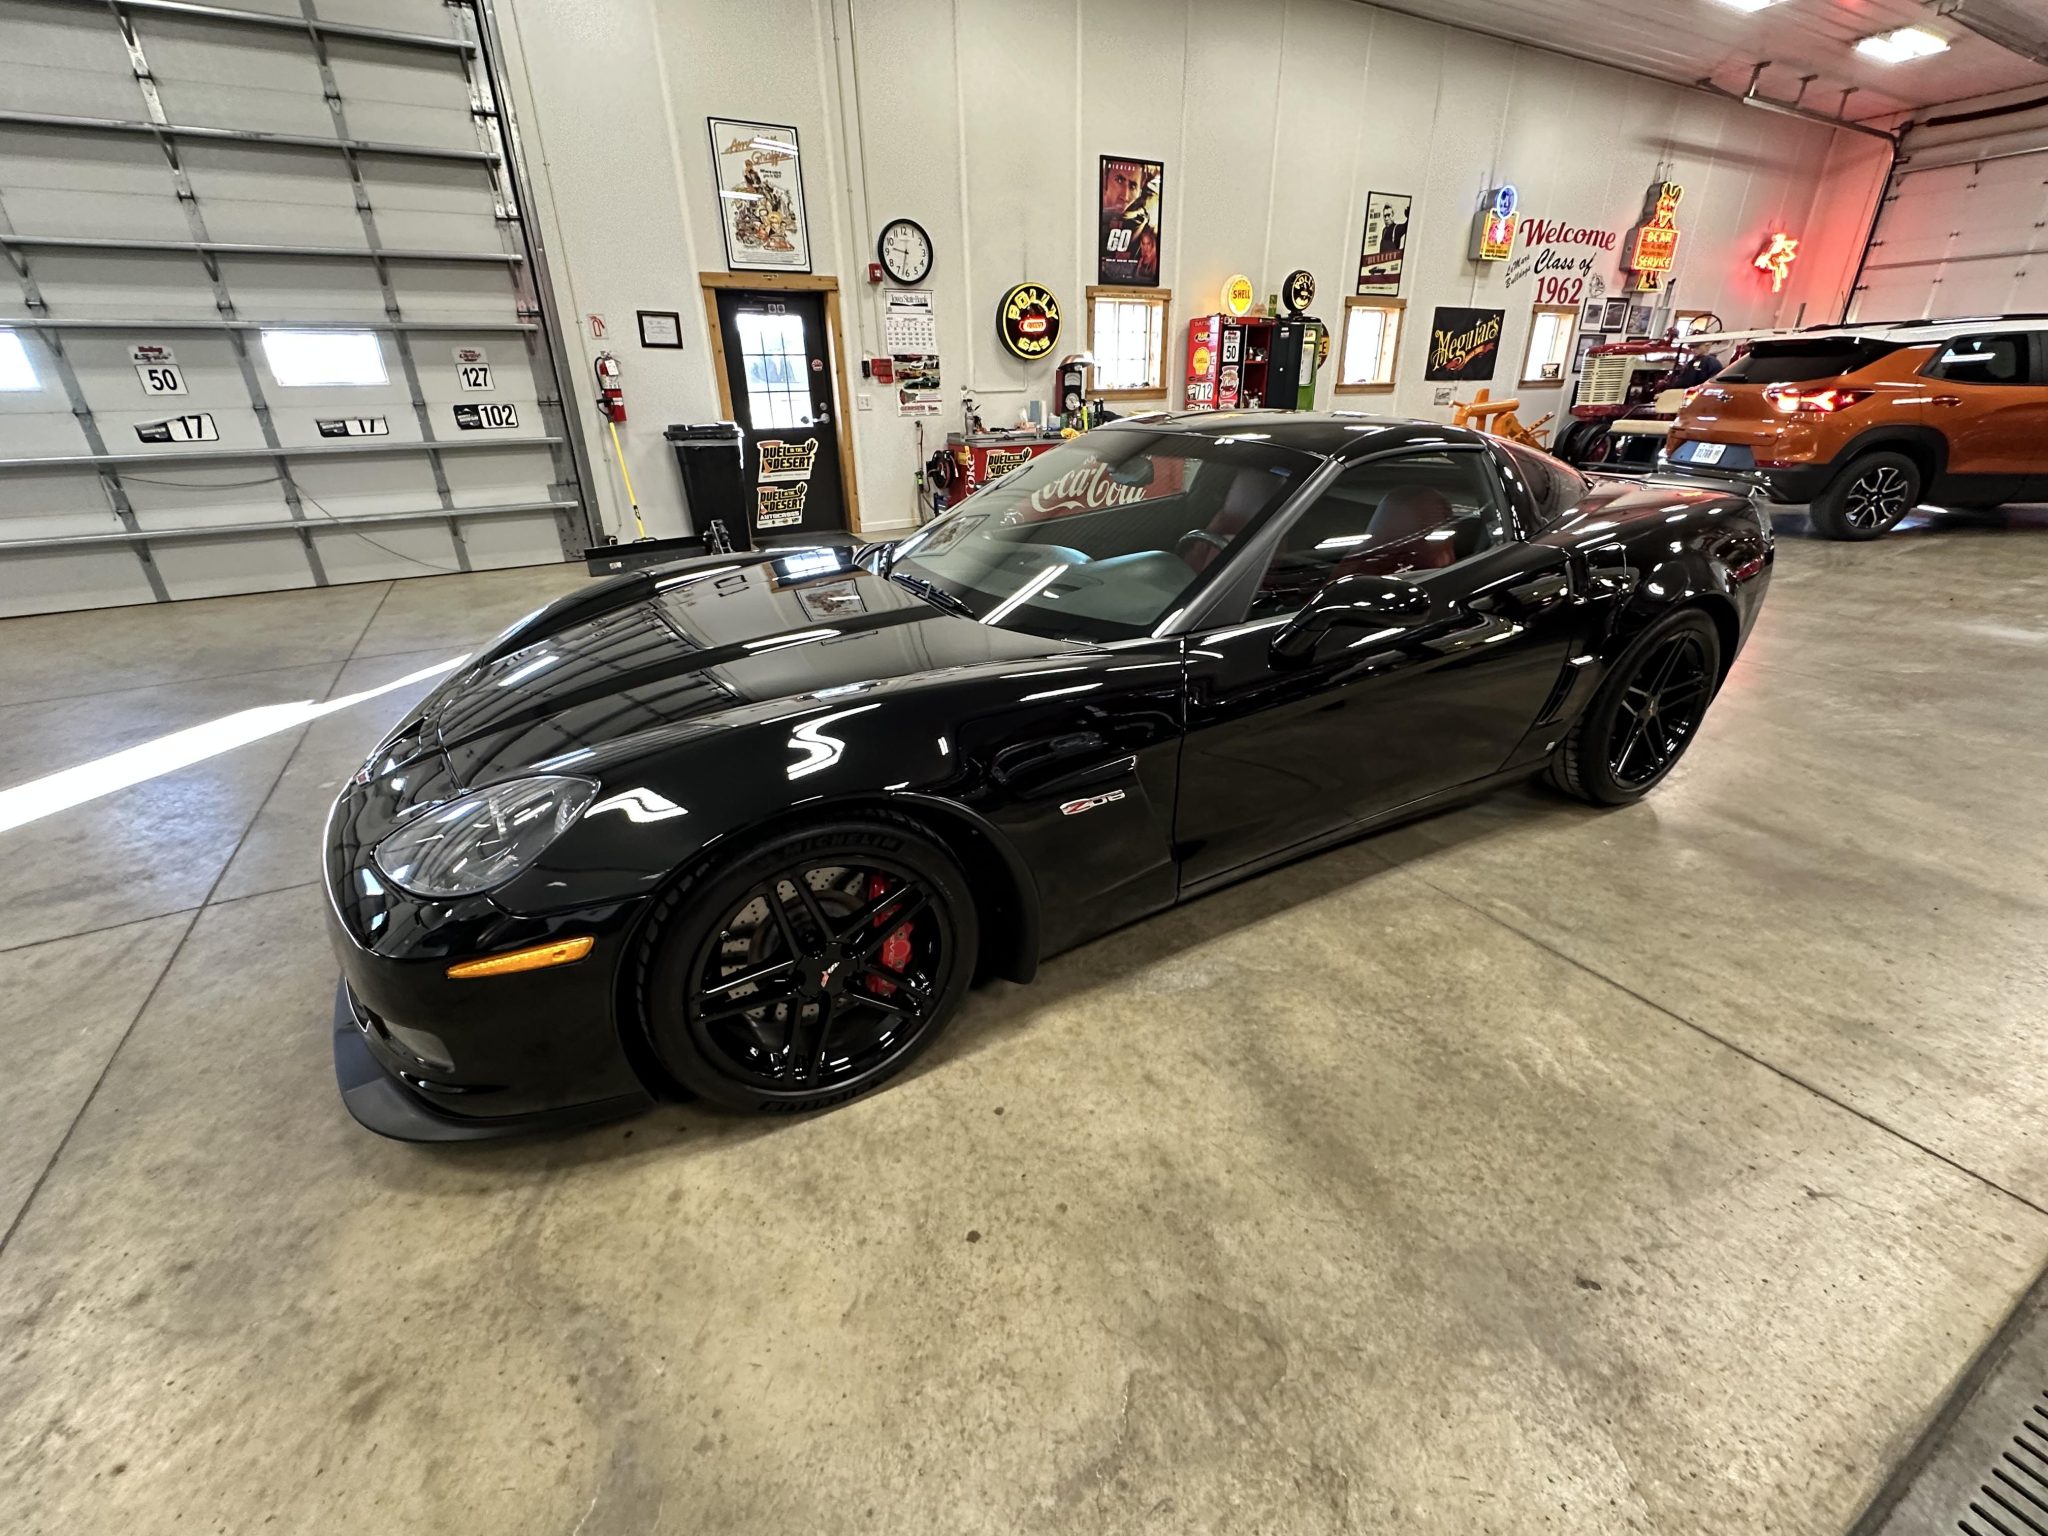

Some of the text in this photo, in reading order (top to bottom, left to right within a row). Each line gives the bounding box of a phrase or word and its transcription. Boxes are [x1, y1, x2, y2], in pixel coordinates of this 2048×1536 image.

[1107, 228, 1132, 252] 60
[1519, 219, 1616, 251] Welcome
[1647, 231, 1672, 243] BEAR
[1534, 248, 1597, 277] Class of
[1638, 256, 1671, 267] SERVICE
[1233, 290, 1250, 300] SHELL
[1534, 276, 1583, 305] 1962
[1008, 289, 1058, 320] POLLY
[1018, 336, 1050, 352] GAS
[1432, 314, 1499, 371] Meguiar's
[1226, 346, 1236, 359] 50
[148, 369, 177, 390] 50
[462, 367, 488, 387] 127
[1197, 384, 1212, 400] 712
[480, 405, 516, 427] 102
[177, 415, 202, 439] 17
[763, 447, 786, 458] DUEL
[988, 455, 1007, 465] DUEL
[773, 456, 812, 469] DESERT
[965, 453, 975, 497] Coke
[761, 491, 781, 501] DUEL
[770, 498, 803, 511] DESERT
[760, 511, 800, 520] AUTOCROSS
[1059, 789, 1126, 815] Z06
